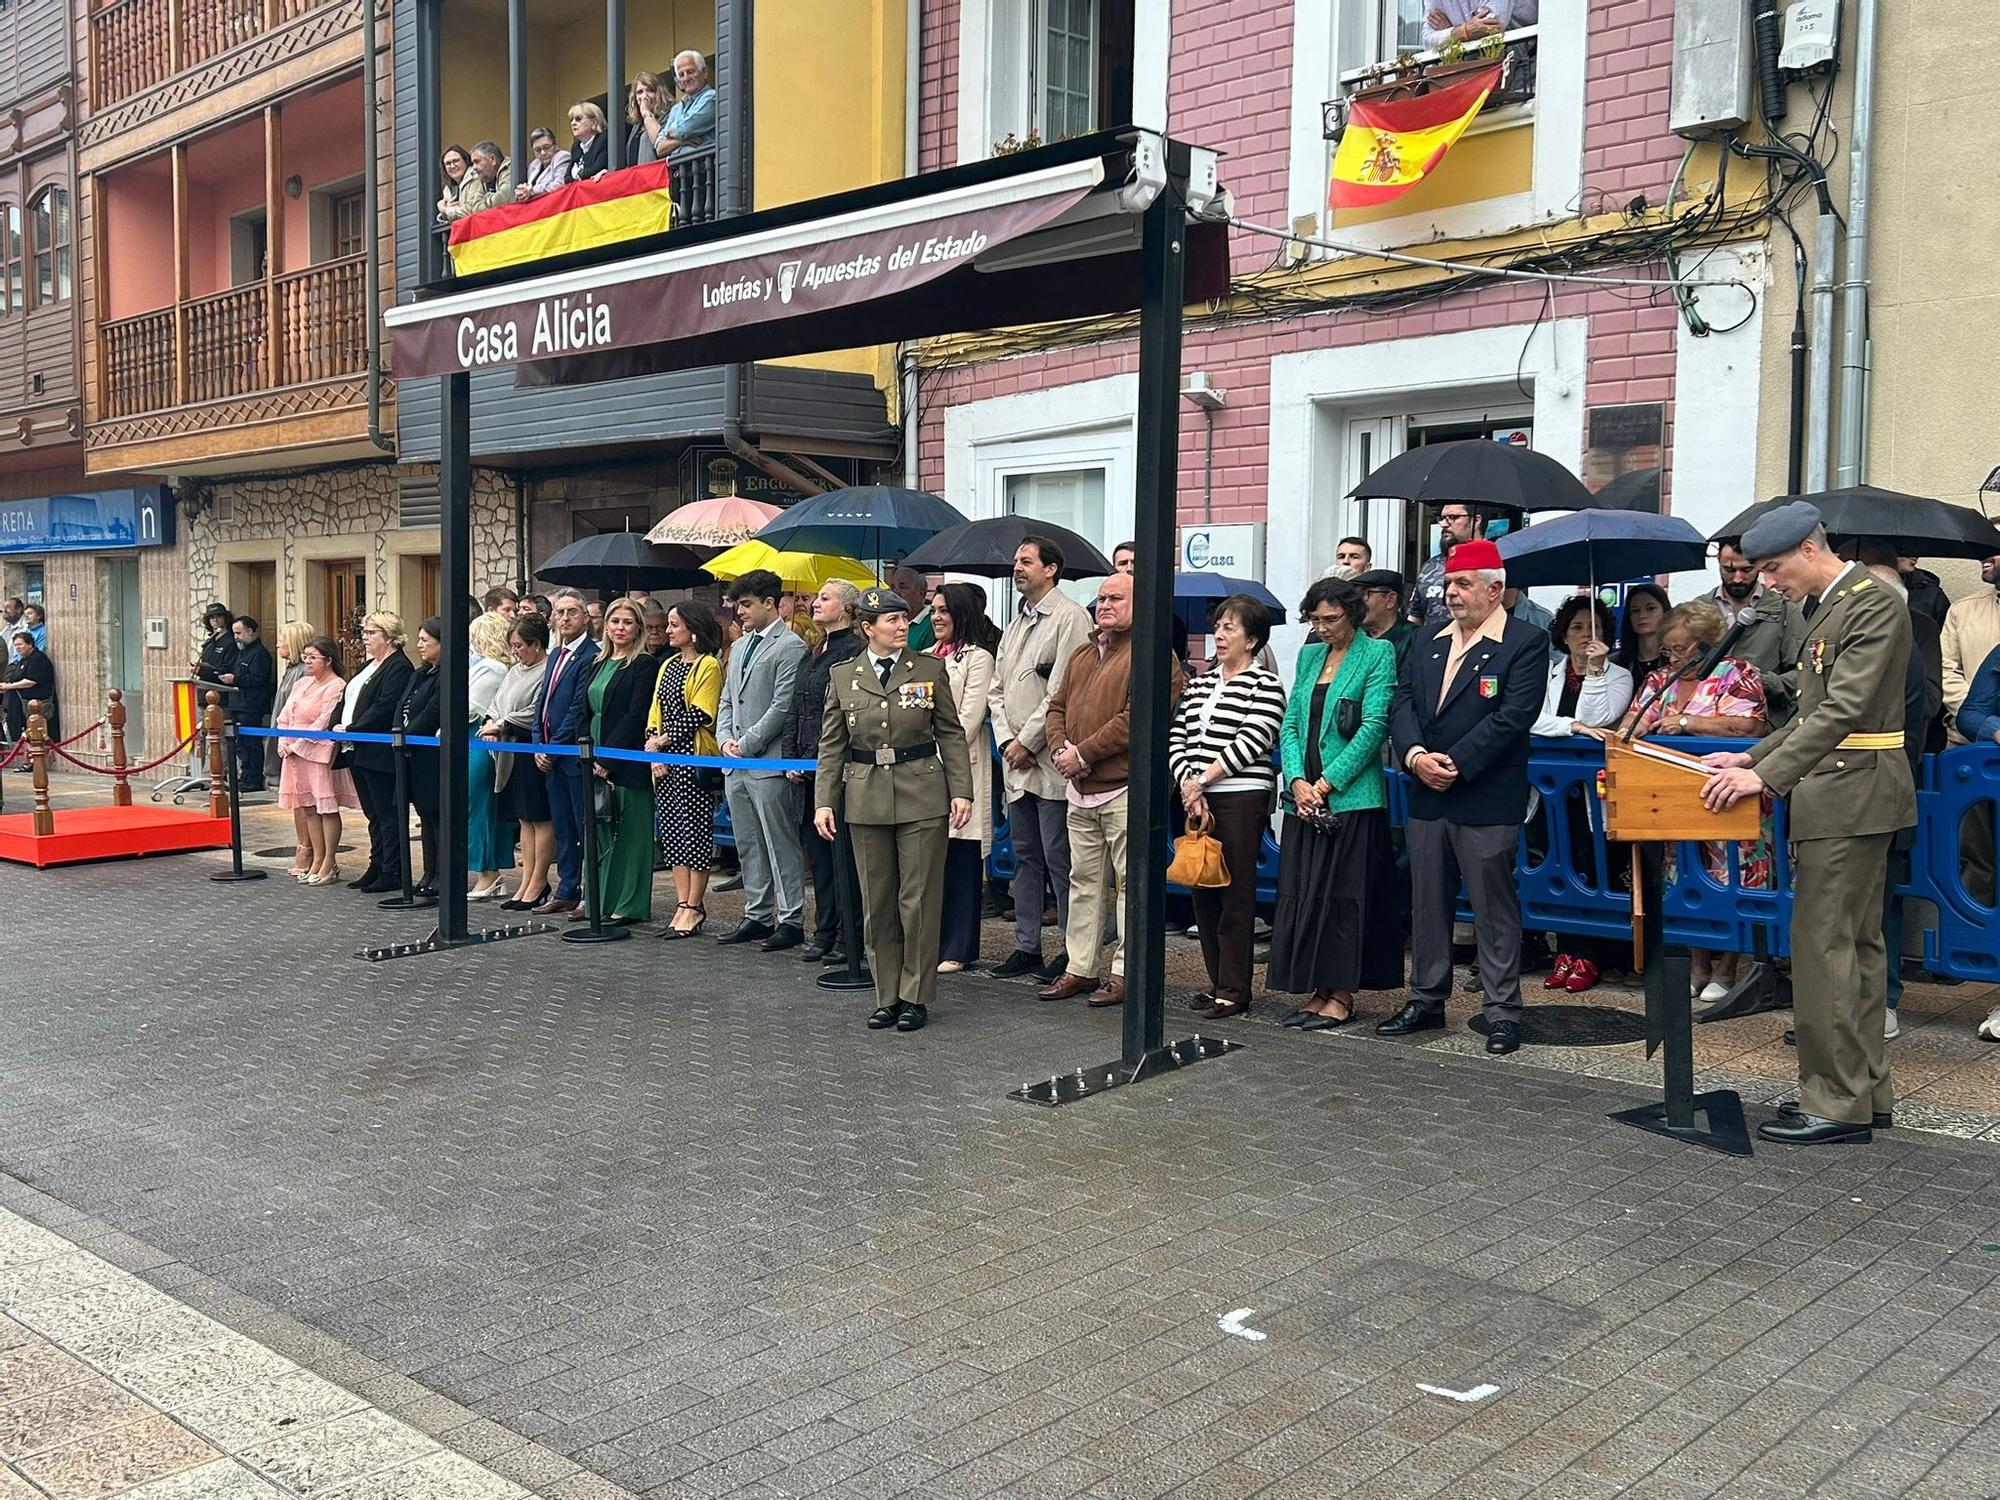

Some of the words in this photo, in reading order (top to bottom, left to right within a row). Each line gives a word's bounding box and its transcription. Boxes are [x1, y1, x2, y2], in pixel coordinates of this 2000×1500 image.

[703, 276, 761, 308] Loterías
[763, 276, 773, 301] y
[802, 254, 881, 290] Apuestas
[888, 245, 920, 272] del
[920, 230, 988, 265] Estado
[457, 316, 518, 368] Casa
[531, 293, 612, 355] Alicia
[1185, 533, 1235, 569] Casa
